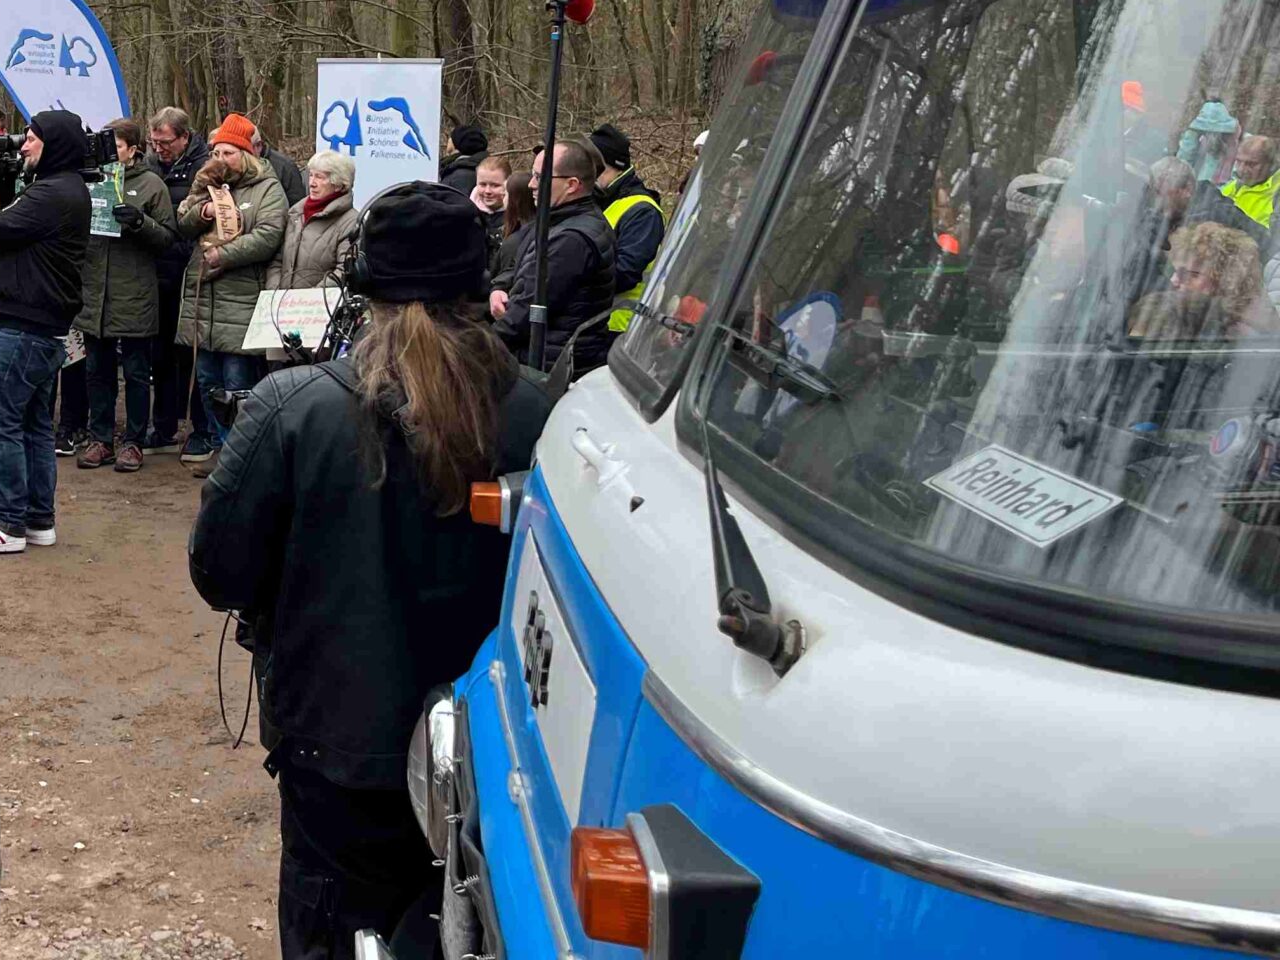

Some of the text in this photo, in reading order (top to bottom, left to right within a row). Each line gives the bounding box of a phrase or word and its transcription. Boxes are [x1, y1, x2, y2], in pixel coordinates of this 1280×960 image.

[367, 127, 399, 136] Initiative
[369, 138, 399, 147] Schönes
[371, 150, 406, 160] Falkensee
[949, 457, 1093, 529] Reinhard
